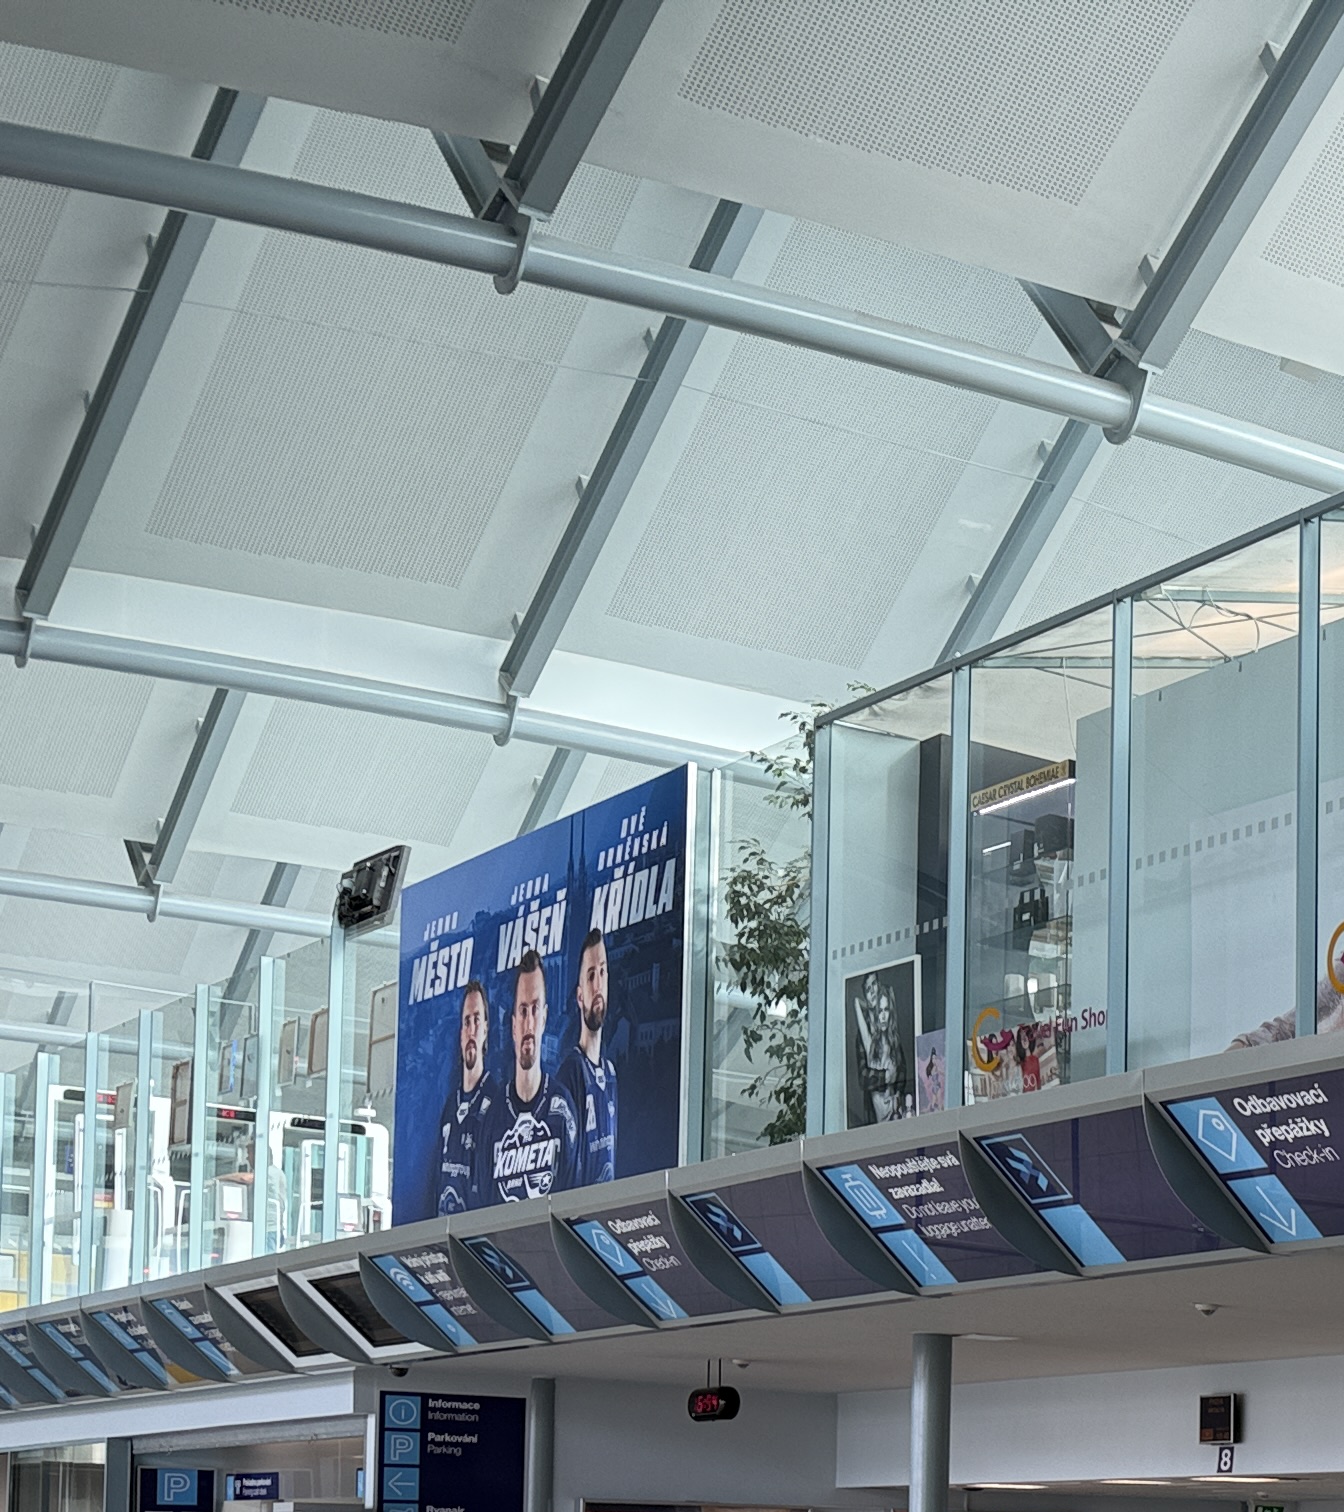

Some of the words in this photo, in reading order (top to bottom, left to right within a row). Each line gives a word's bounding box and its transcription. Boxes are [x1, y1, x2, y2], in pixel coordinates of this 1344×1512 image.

[972, 788, 1000, 808] CAESAR
[998, 778, 1025, 799] CRYSTAL
[1025, 766, 1060, 789] BOHEMIAE
[590, 858, 677, 935] KŘÍDLA
[497, 887, 568, 973] VÁŠEŇ
[408, 936, 474, 1006] MĚSTO
[1081, 1007, 1108, 1031] Sho
[1233, 1082, 1329, 1116] Odbavovací
[1255, 1117, 1330, 1147] přepážky
[493, 1138, 554, 1180] KOMETA
[1273, 1144, 1341, 1168] Check-in
[428, 1398, 480, 1410] Informace
[428, 1411, 479, 1422] Information
[427, 1433, 478, 1444] Parkování
[427, 1444, 462, 1456] Parking
[1220, 1448, 1232, 1471] 8
